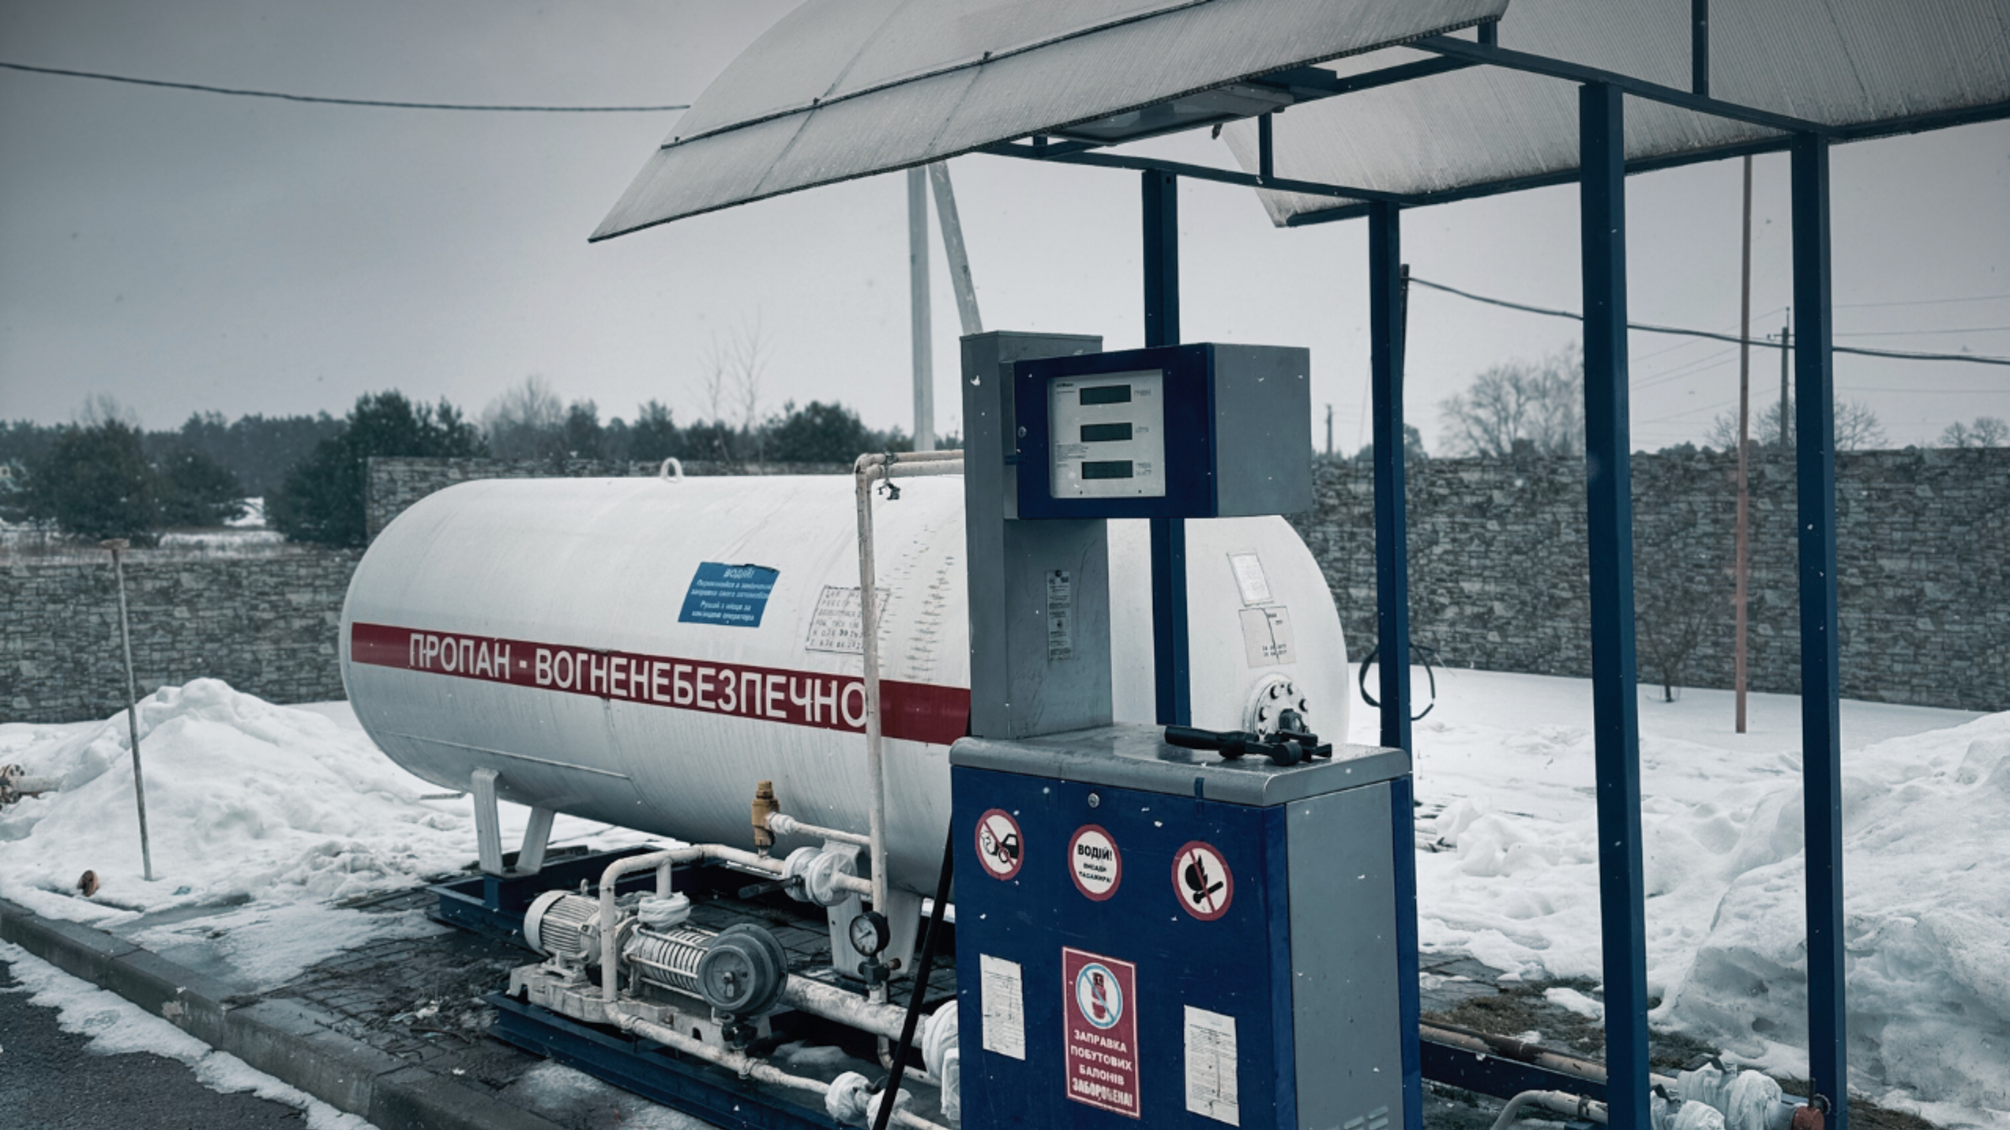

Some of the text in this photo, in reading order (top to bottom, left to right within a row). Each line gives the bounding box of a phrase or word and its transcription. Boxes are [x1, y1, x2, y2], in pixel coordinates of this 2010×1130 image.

[408, 632, 511, 681] ПРОПАН
[534, 647, 868, 728] ВОГНЕНЕБЕЗПЕЧНО
[1077, 843, 1113, 861] ВОДІЙ!
[1073, 1029, 1127, 1053] ЗАПРАВКА
[1070, 1045, 1133, 1071] ПОБУТОВИХ
[1079, 1064, 1125, 1086] БАЛОНІВ
